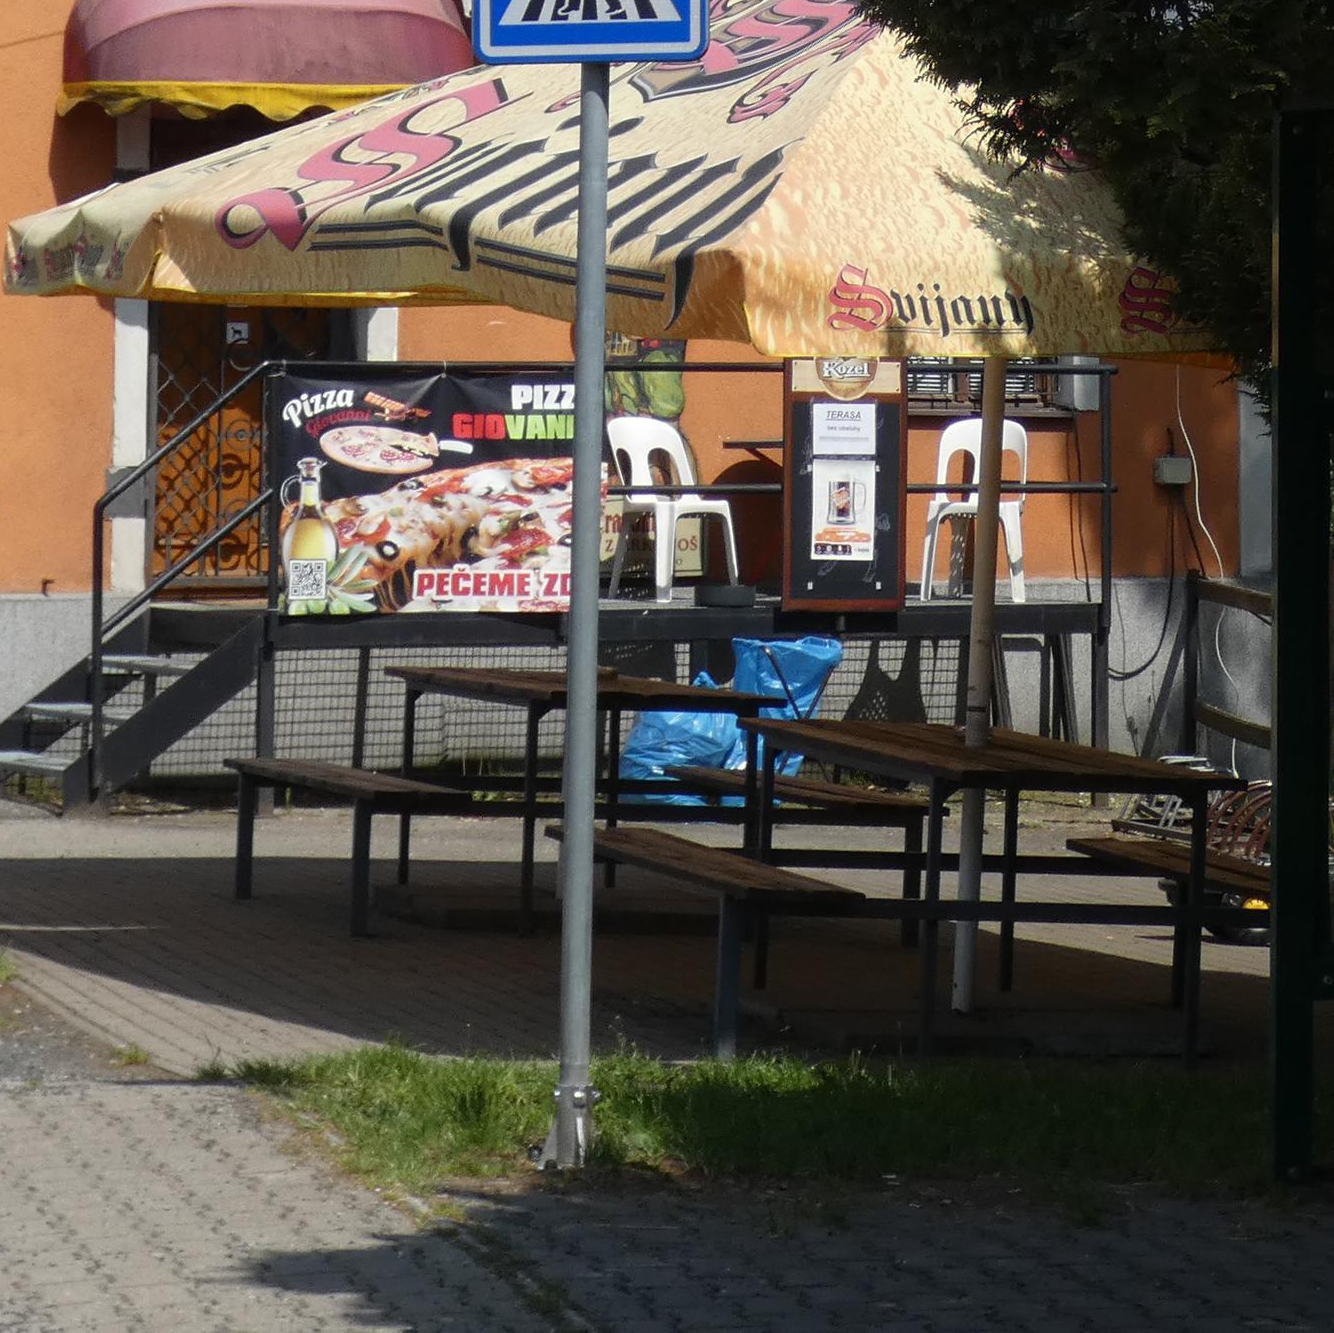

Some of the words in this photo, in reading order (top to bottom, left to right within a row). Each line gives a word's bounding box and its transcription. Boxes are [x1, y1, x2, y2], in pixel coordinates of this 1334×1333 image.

[826, 263, 1035, 338] Svijany
[822, 357, 871, 380] Kozel
[282, 388, 355, 429] Pizza
[511, 384, 575, 410] PIZZ
[826, 410, 862, 420] TERASA
[417, 568, 531, 597] PEČEME
